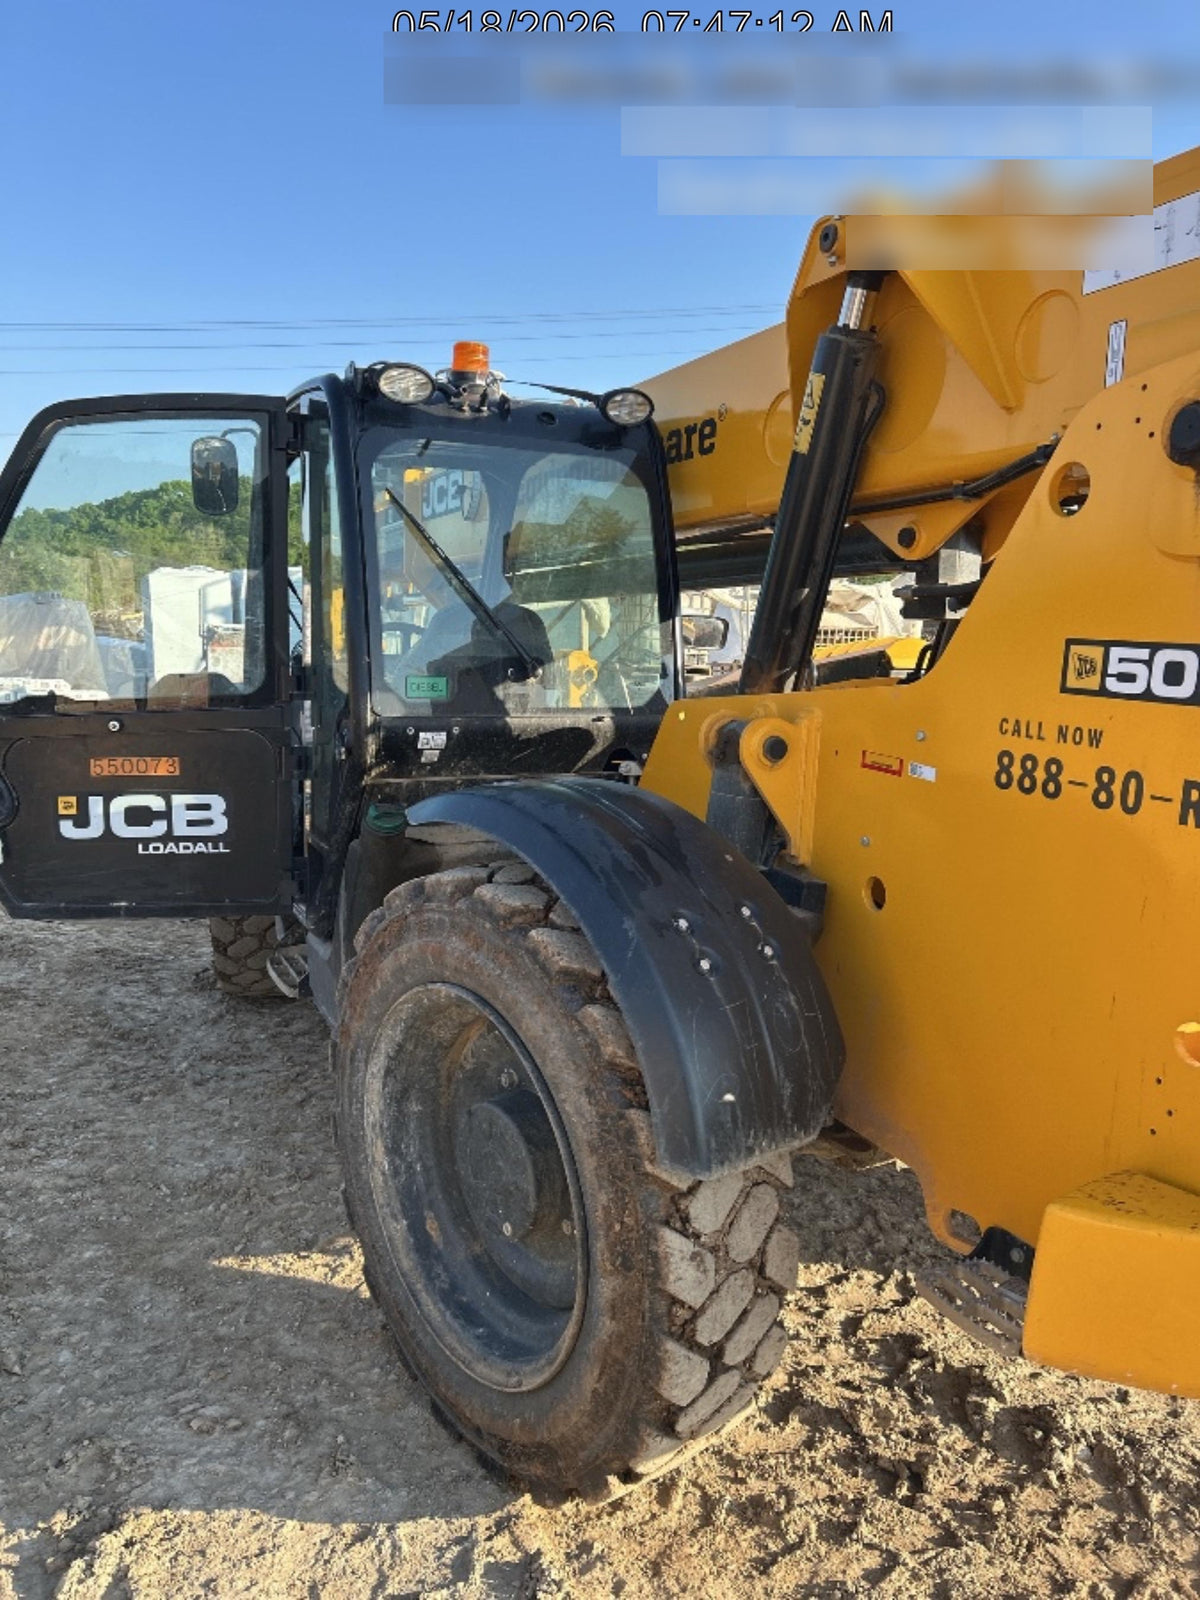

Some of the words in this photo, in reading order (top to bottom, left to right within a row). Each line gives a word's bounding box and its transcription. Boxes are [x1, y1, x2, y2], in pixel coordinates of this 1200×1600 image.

[409, 681, 444, 693] DIESEL
[999, 717, 1046, 741] CALL
[1057, 724, 1104, 749] NOW
[93, 757, 178, 776] 550073
[58, 794, 228, 840] JCB
[138, 842, 231, 855] LOADALL
